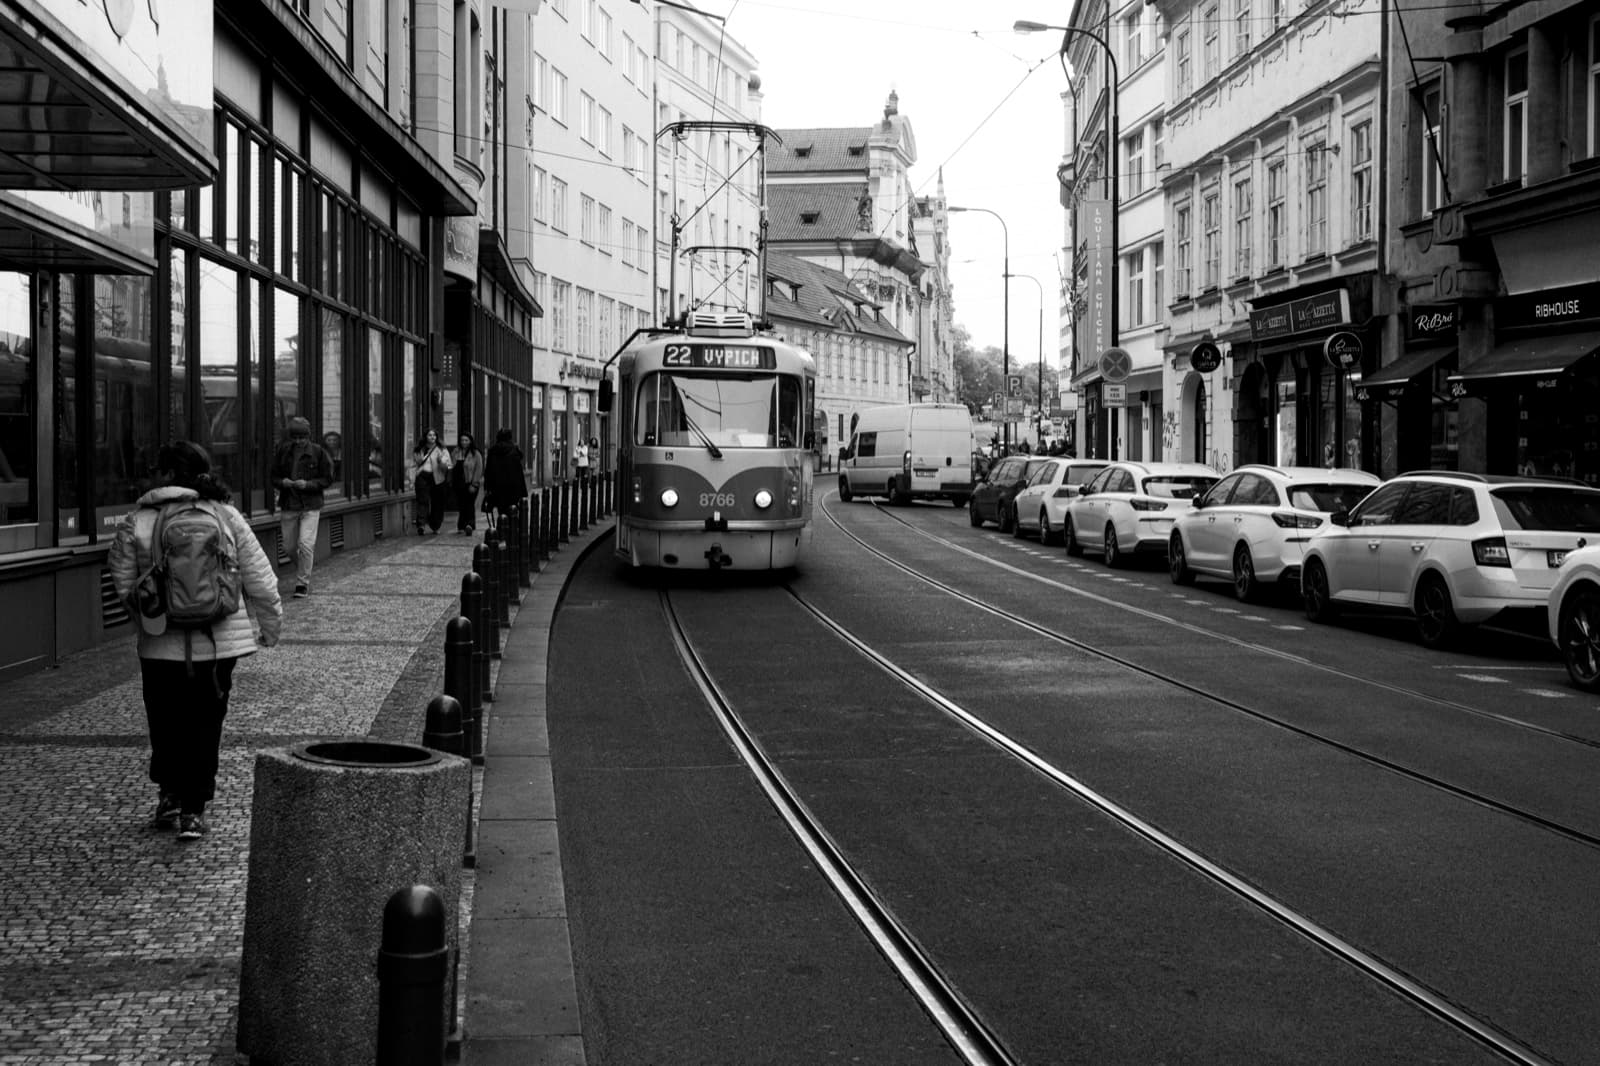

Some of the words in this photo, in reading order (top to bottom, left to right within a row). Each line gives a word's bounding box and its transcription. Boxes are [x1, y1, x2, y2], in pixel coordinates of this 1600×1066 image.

[1094, 207, 1103, 286] LOUISIANA
[1535, 299, 1580, 318] RIBHOUSE
[1095, 294, 1103, 353] CHICKEN
[666, 346, 692, 364] 22
[704, 348, 760, 366] VYPICH
[699, 493, 736, 507] 8766
